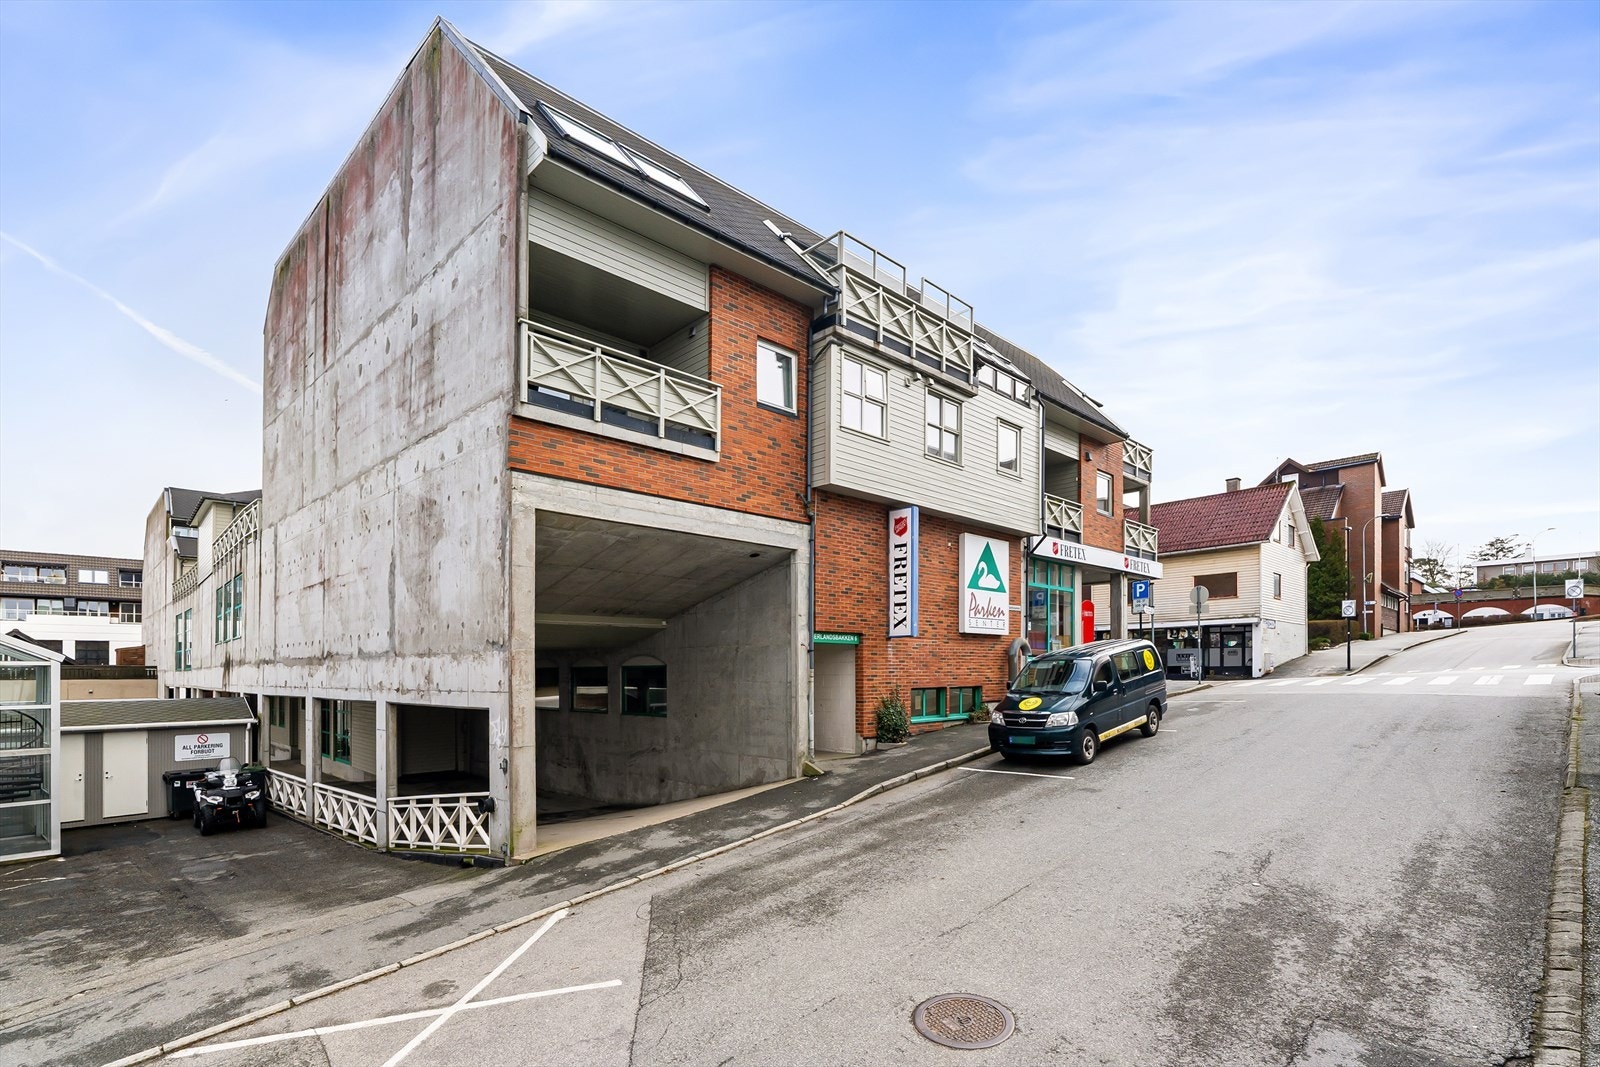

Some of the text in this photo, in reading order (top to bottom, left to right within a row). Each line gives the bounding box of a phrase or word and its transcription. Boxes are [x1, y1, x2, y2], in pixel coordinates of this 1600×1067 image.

[1060, 543, 1087, 561] FRETEX
[1130, 560, 1151, 574] FRETEX
[893, 541, 908, 630] FRETEX
[1136, 583, 1146, 598] P
[968, 591, 1006, 619] Parken
[968, 618, 1006, 628] SENTER
